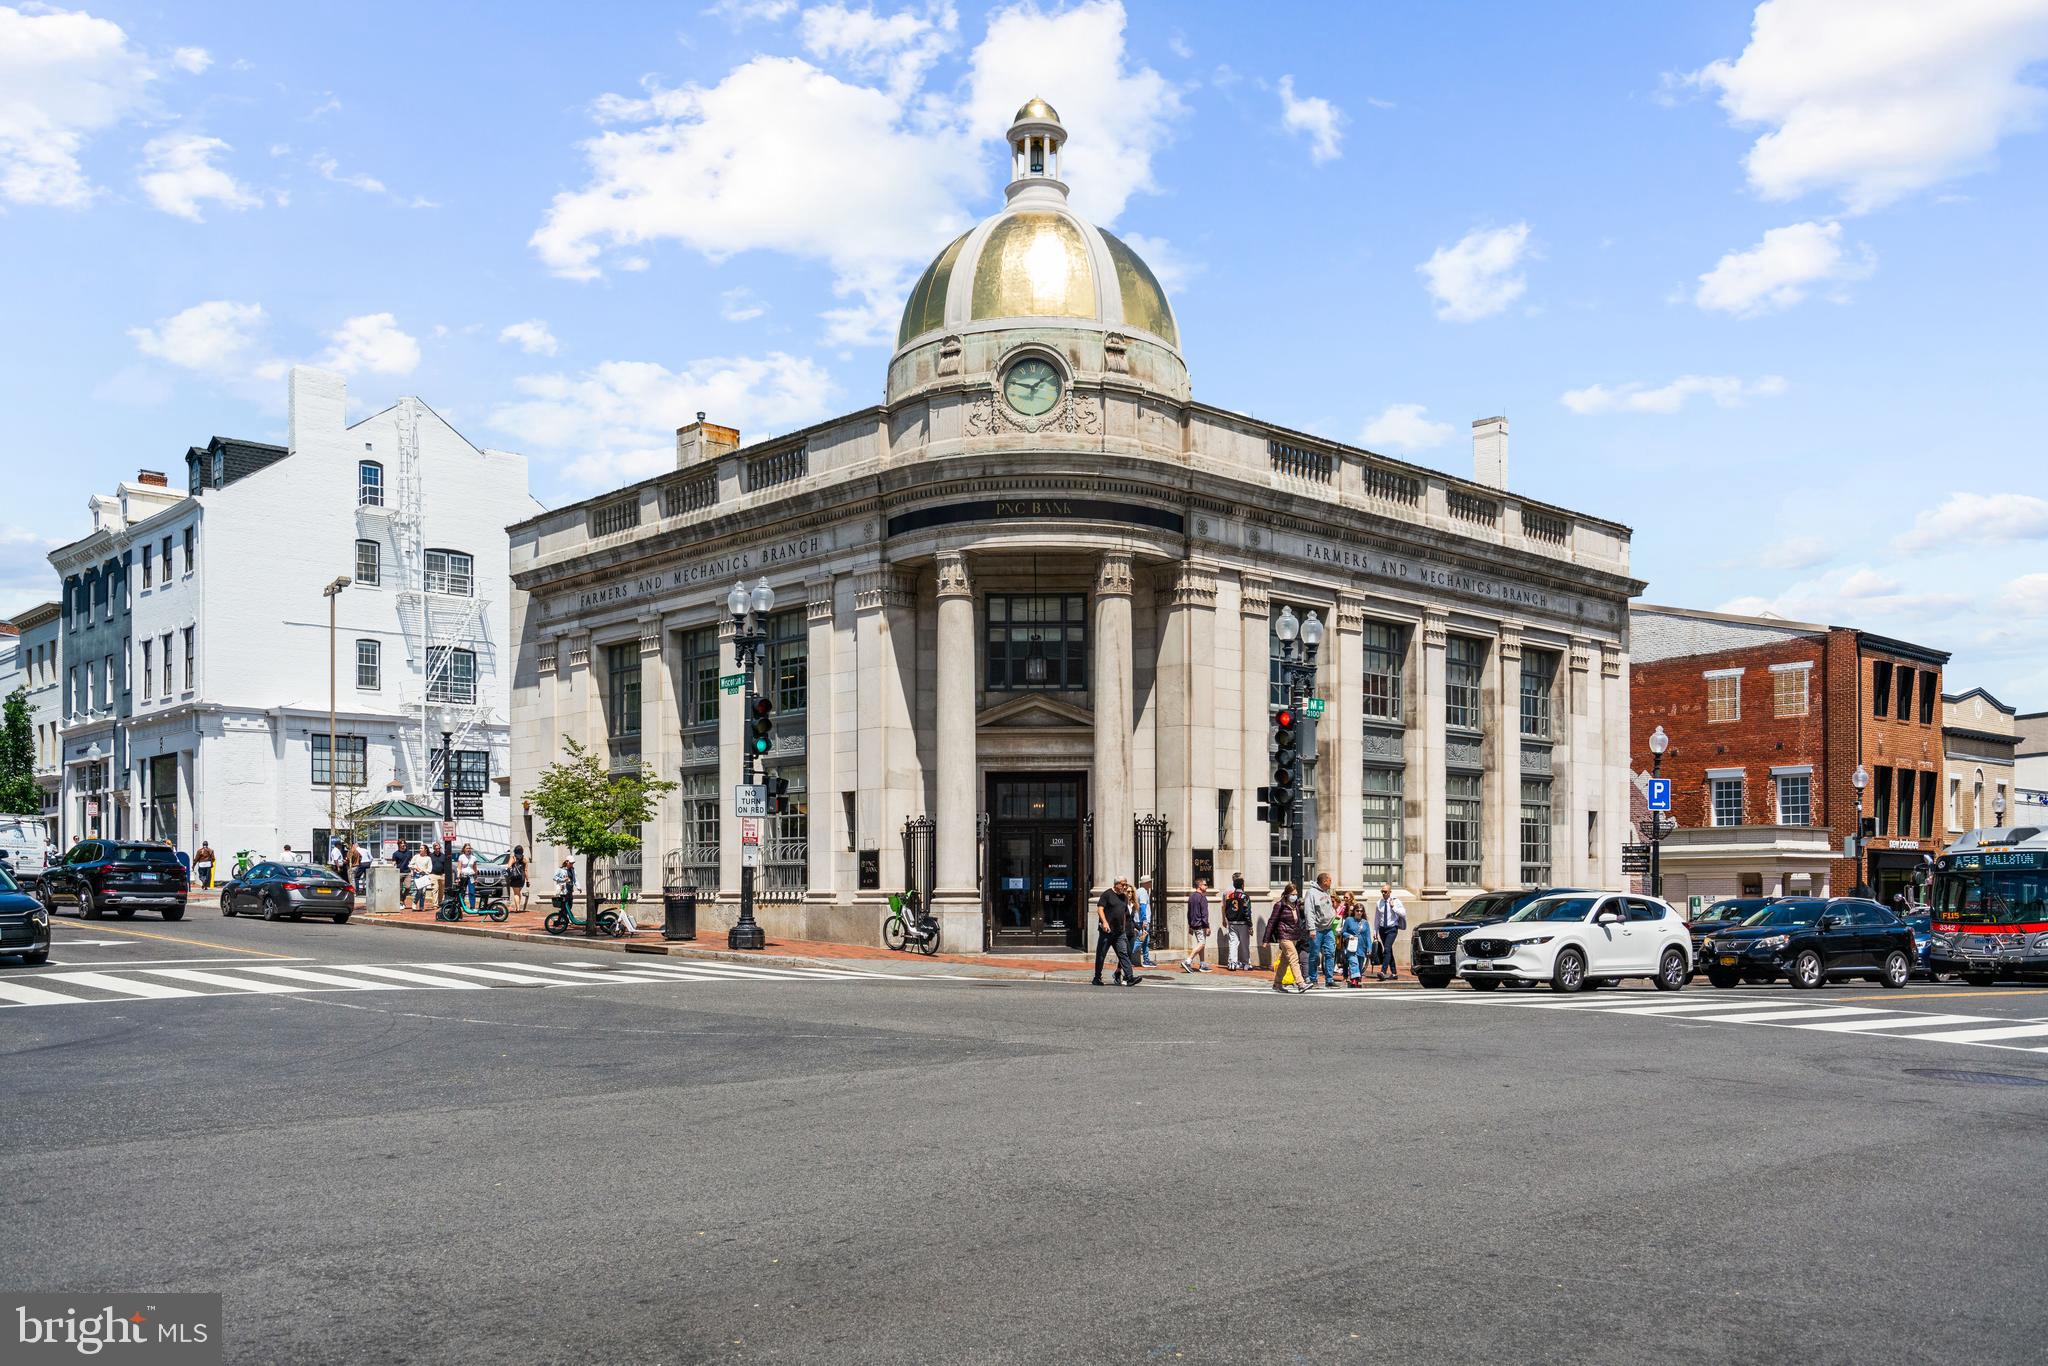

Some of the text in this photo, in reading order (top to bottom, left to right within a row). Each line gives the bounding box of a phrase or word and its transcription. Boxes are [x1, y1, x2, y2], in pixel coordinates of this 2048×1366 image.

[996, 502, 1072, 515] PNC BANK
[579, 537, 818, 607] FARMERS AND MECHANICS BRANCH
[1306, 543, 1547, 607] FARMERS AND MECHANICS BRANCH
[1310, 700, 1317, 710] M
[1306, 710, 1320, 718] 3100
[1654, 782, 1664, 799] P
[751, 806, 765, 814] RED
